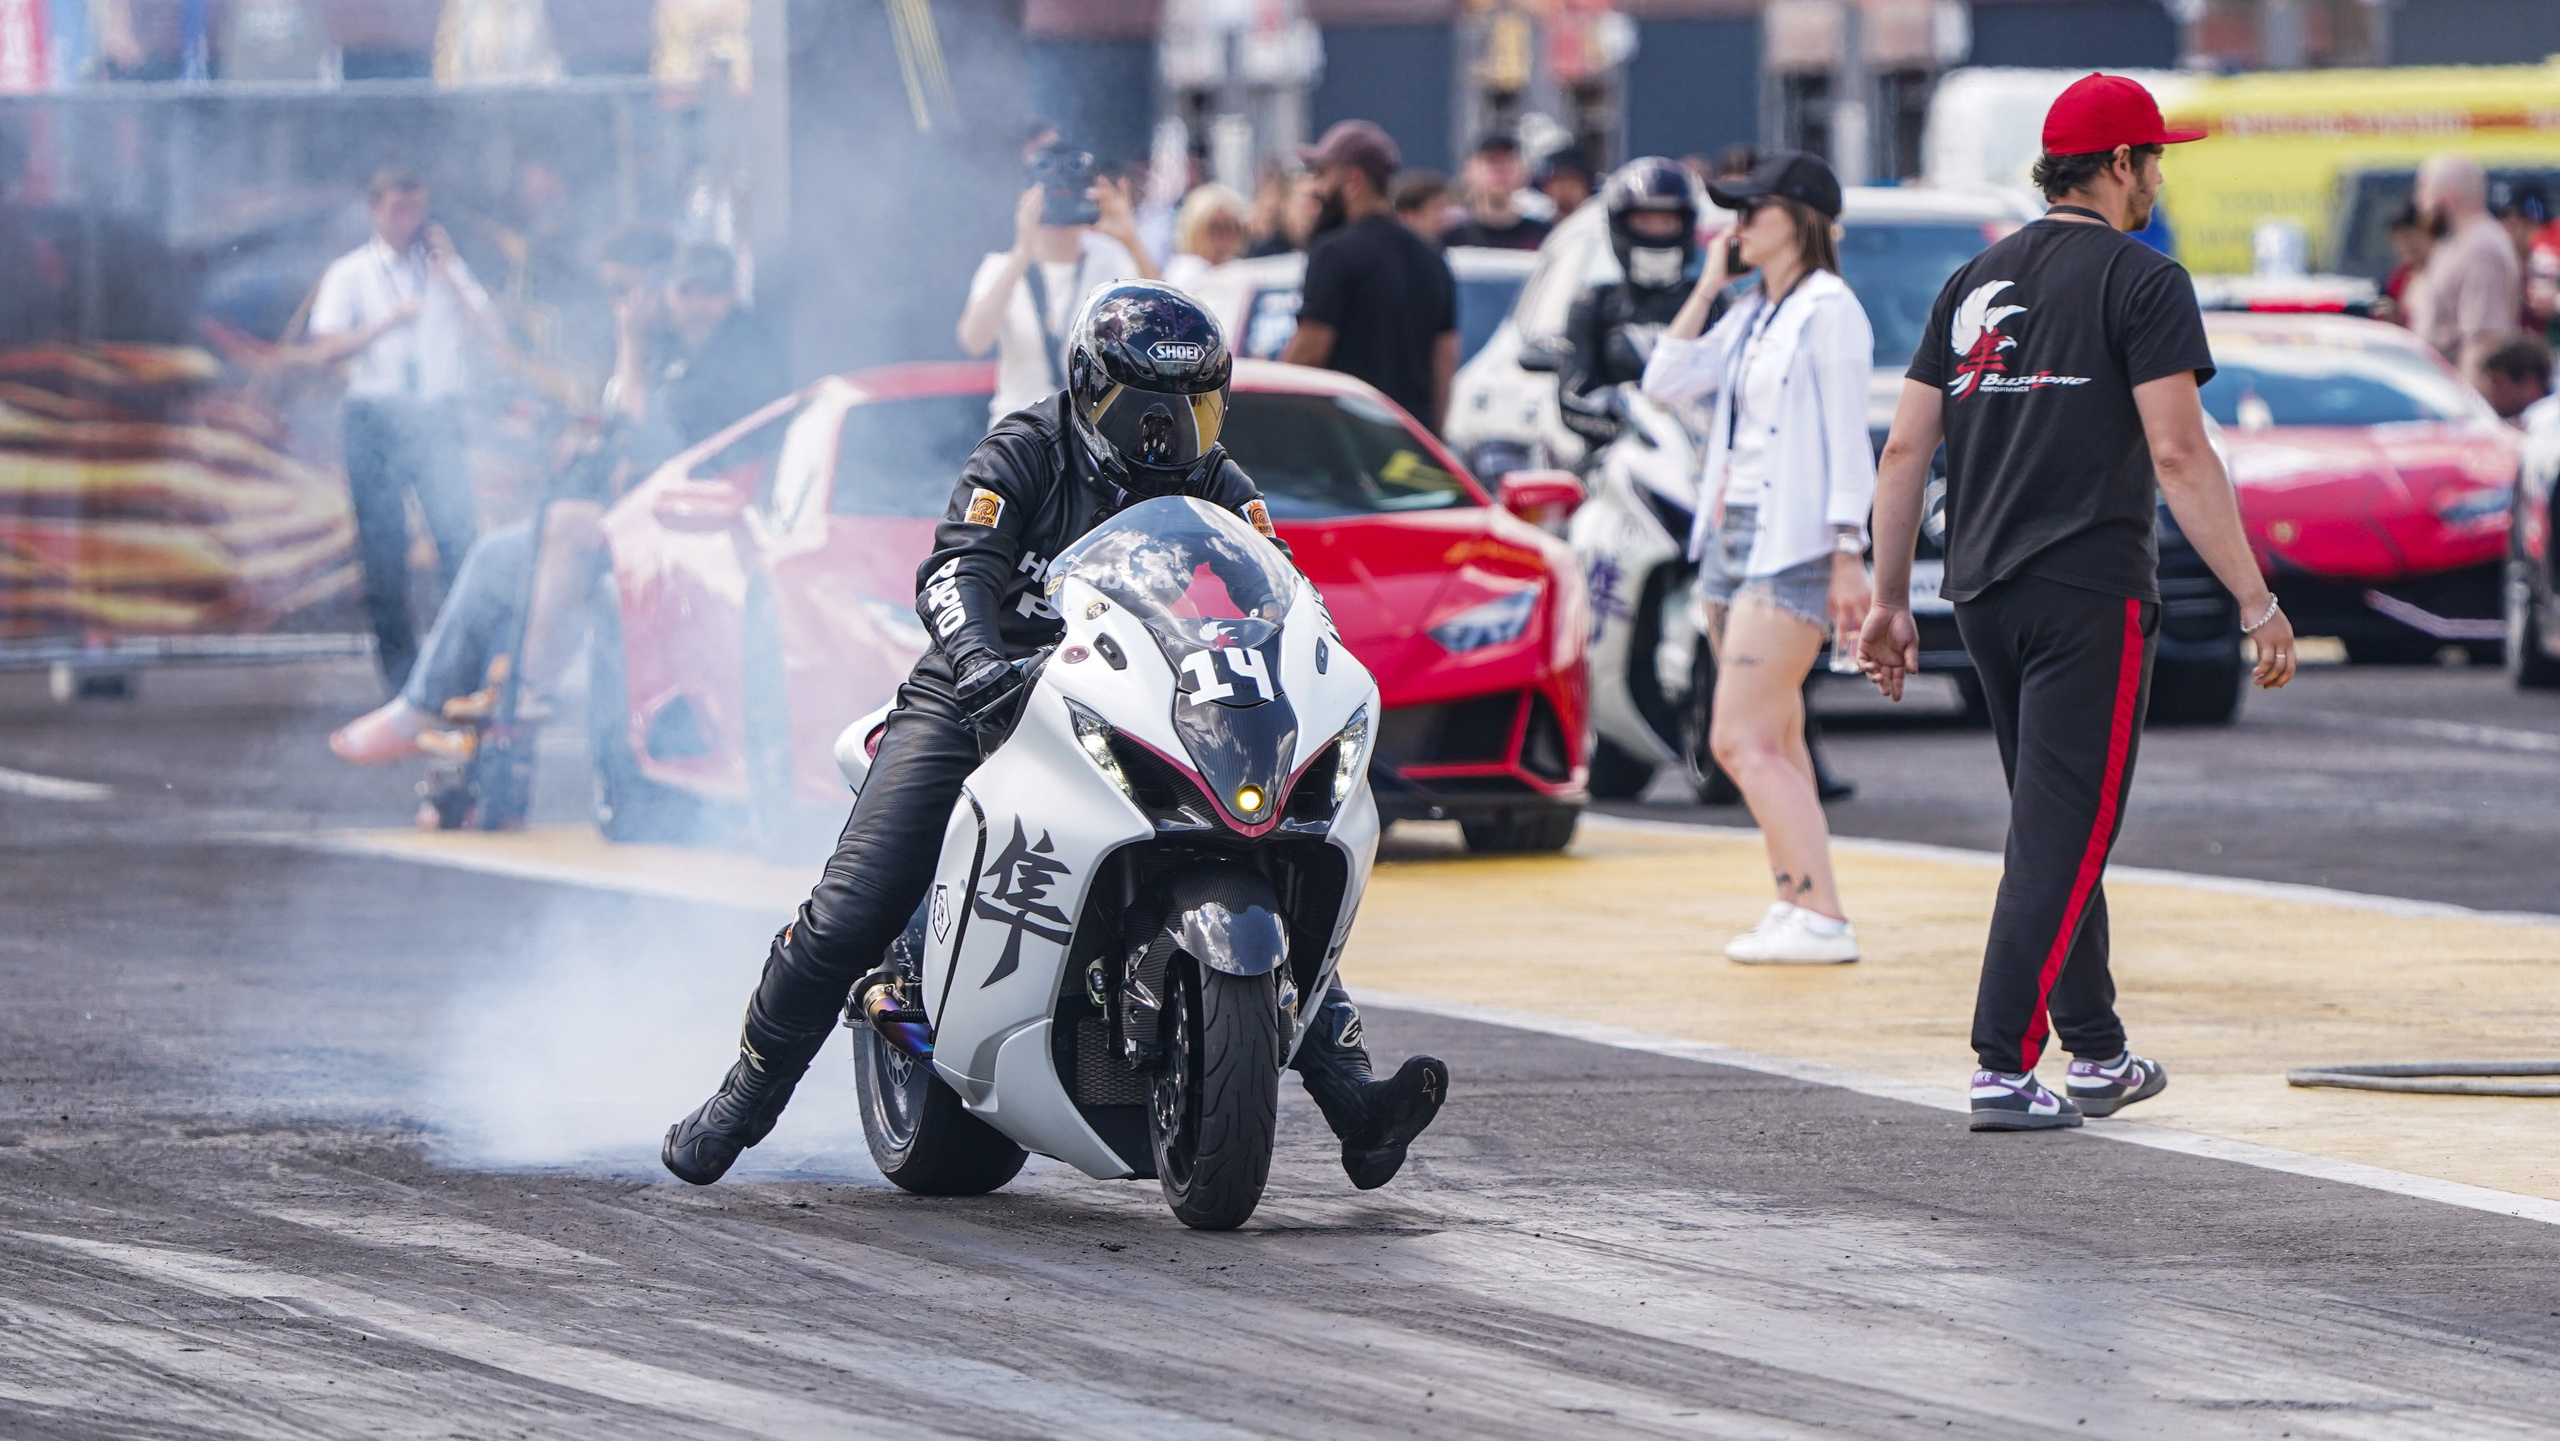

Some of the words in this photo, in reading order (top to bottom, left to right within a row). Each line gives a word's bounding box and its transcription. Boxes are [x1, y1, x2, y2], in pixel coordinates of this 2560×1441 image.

[1156, 345, 1198, 360] SHOEI
[1180, 647, 1275, 706] 14
[973, 812, 1073, 990] 隼
